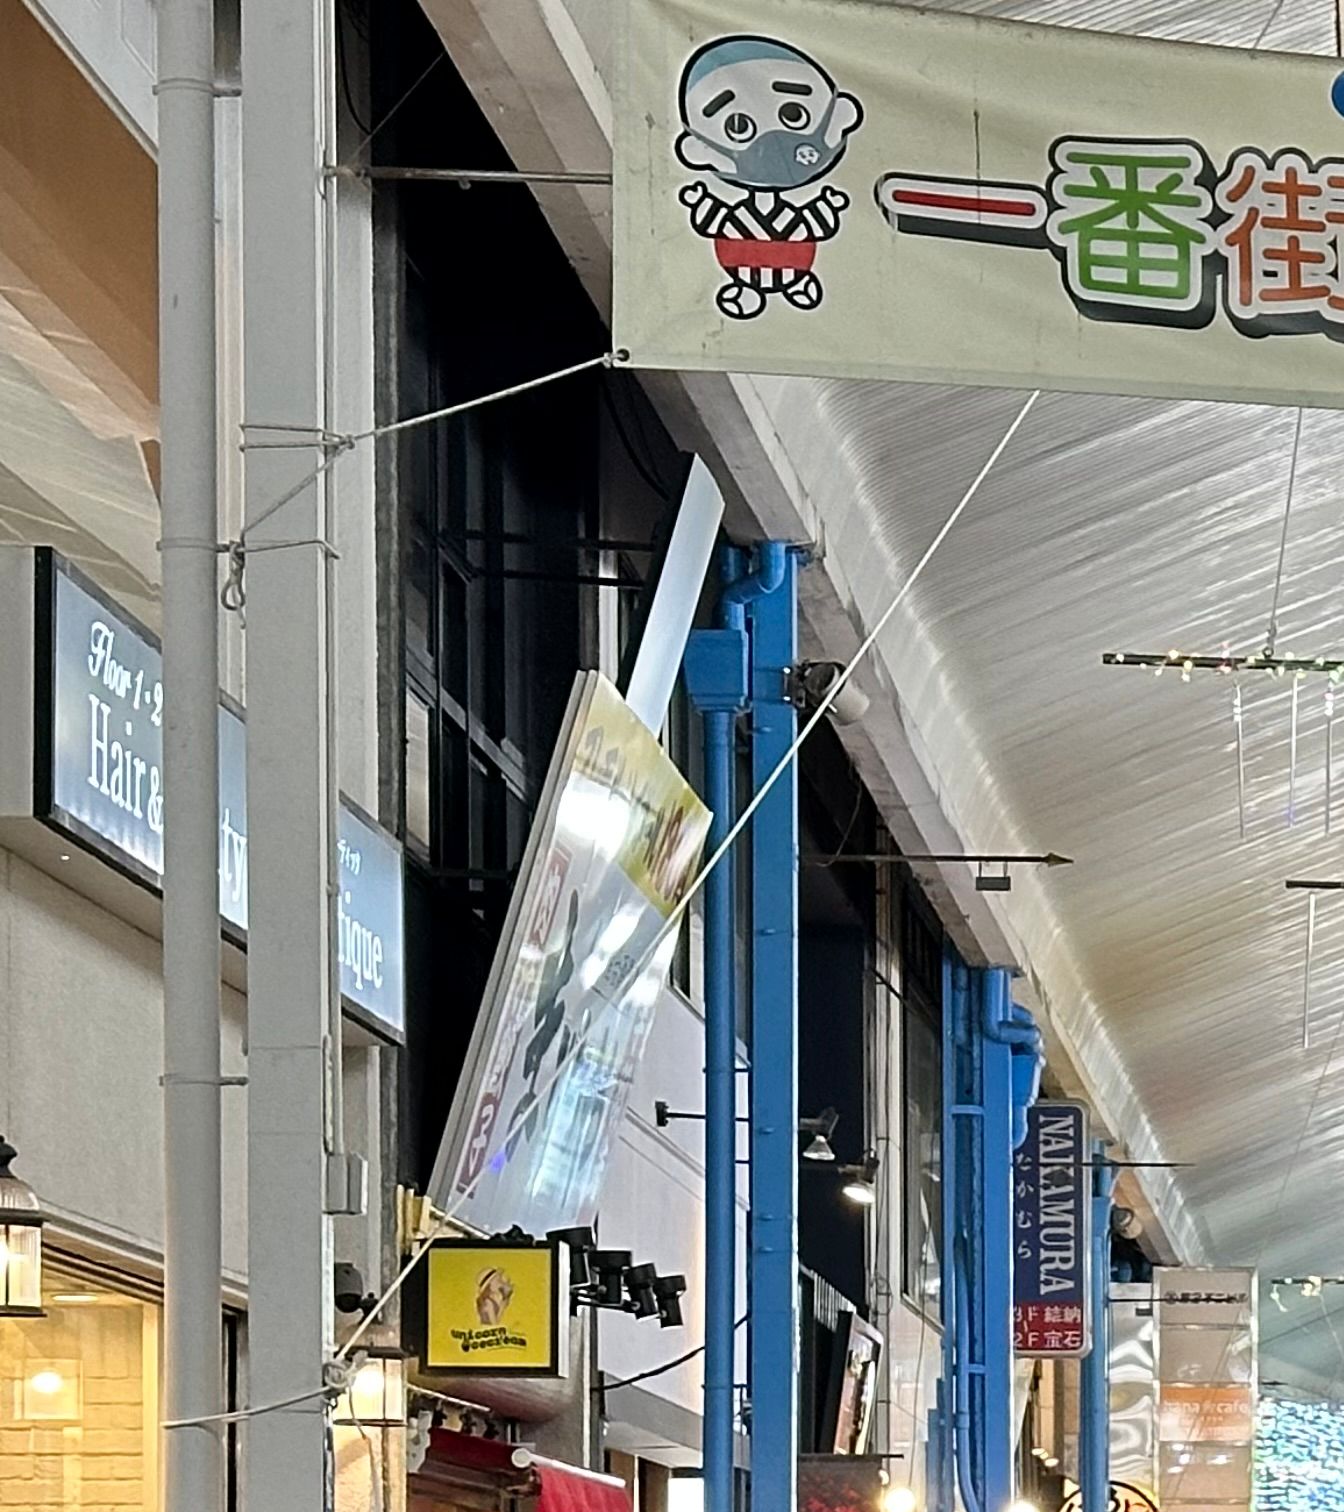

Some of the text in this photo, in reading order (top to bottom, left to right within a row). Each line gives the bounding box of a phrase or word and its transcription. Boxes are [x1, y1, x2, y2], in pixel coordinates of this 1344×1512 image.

[88, 622, 132, 699] Floor
[88, 694, 146, 820] Hair
[1015, 1153, 1035, 1260] なかむら
[1039, 1115, 1076, 1295] NAKAMURA
